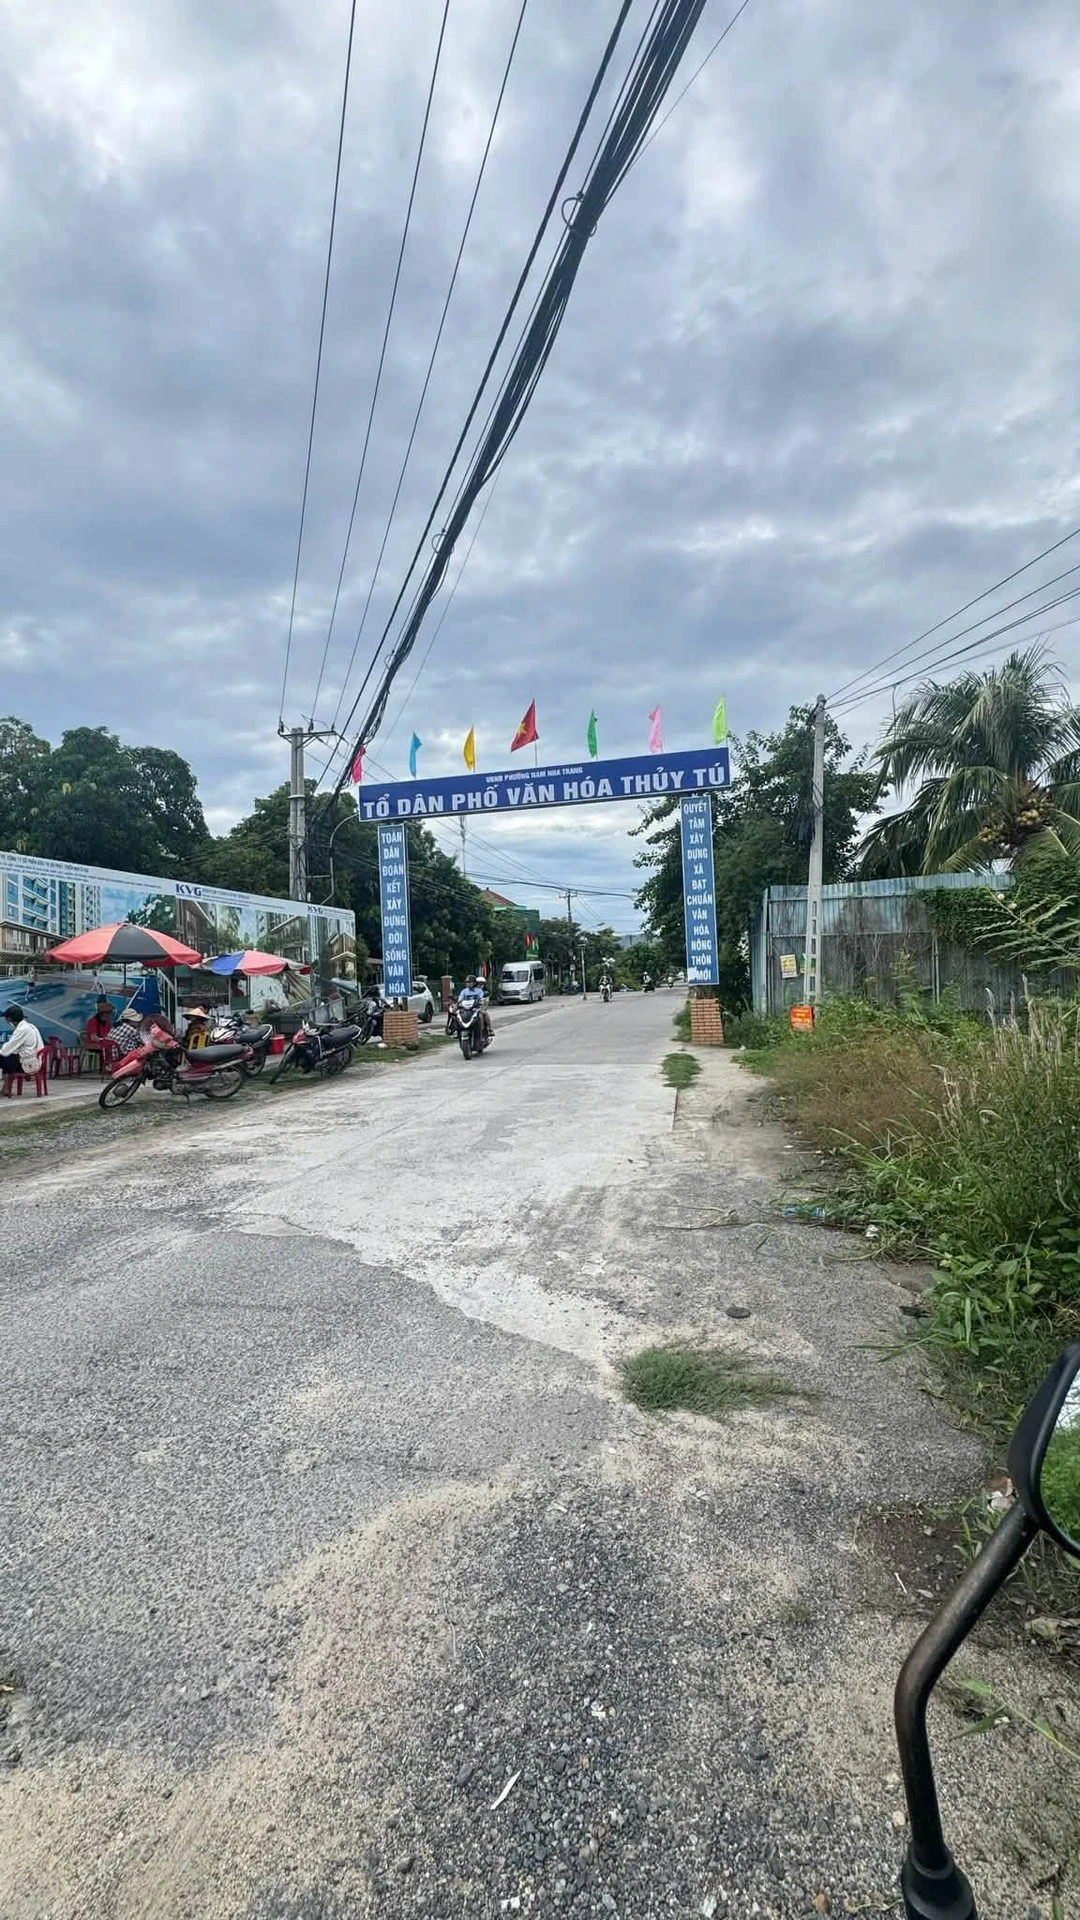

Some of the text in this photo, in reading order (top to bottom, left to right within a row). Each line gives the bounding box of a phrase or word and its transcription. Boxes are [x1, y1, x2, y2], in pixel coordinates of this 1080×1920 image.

[530, 770, 546, 778] NAM
[547, 768, 561, 777] NHA
[562, 766, 583, 775] TRANG
[363, 762, 725, 818] TỔ DÂN PHỐ VĂN HÓA THỦY TÚ
[683, 799, 707, 815] QUYẾT
[689, 817, 705, 829] TÂM
[381, 831, 402, 844] TOÀN
[689, 832, 704, 844] XÂY
[383, 845, 400, 860] DÂN
[382, 862, 404, 877] ĐOÀN
[175, 883, 202, 897] KVG
[386, 878, 402, 893] KẾT
[386, 896, 402, 910] XÂY
[384, 914, 406, 928] DỰNG
[692, 907, 708, 921] VĂN
[388, 929, 403, 944] ĐỜI
[693, 923, 710, 936] HÓA
[691, 938, 712, 951] NÔNG
[385, 946, 407, 961] SỐNG
[691, 953, 712, 966] THÔN
[388, 963, 404, 977] VĂN
[388, 979, 406, 994] HÓA
